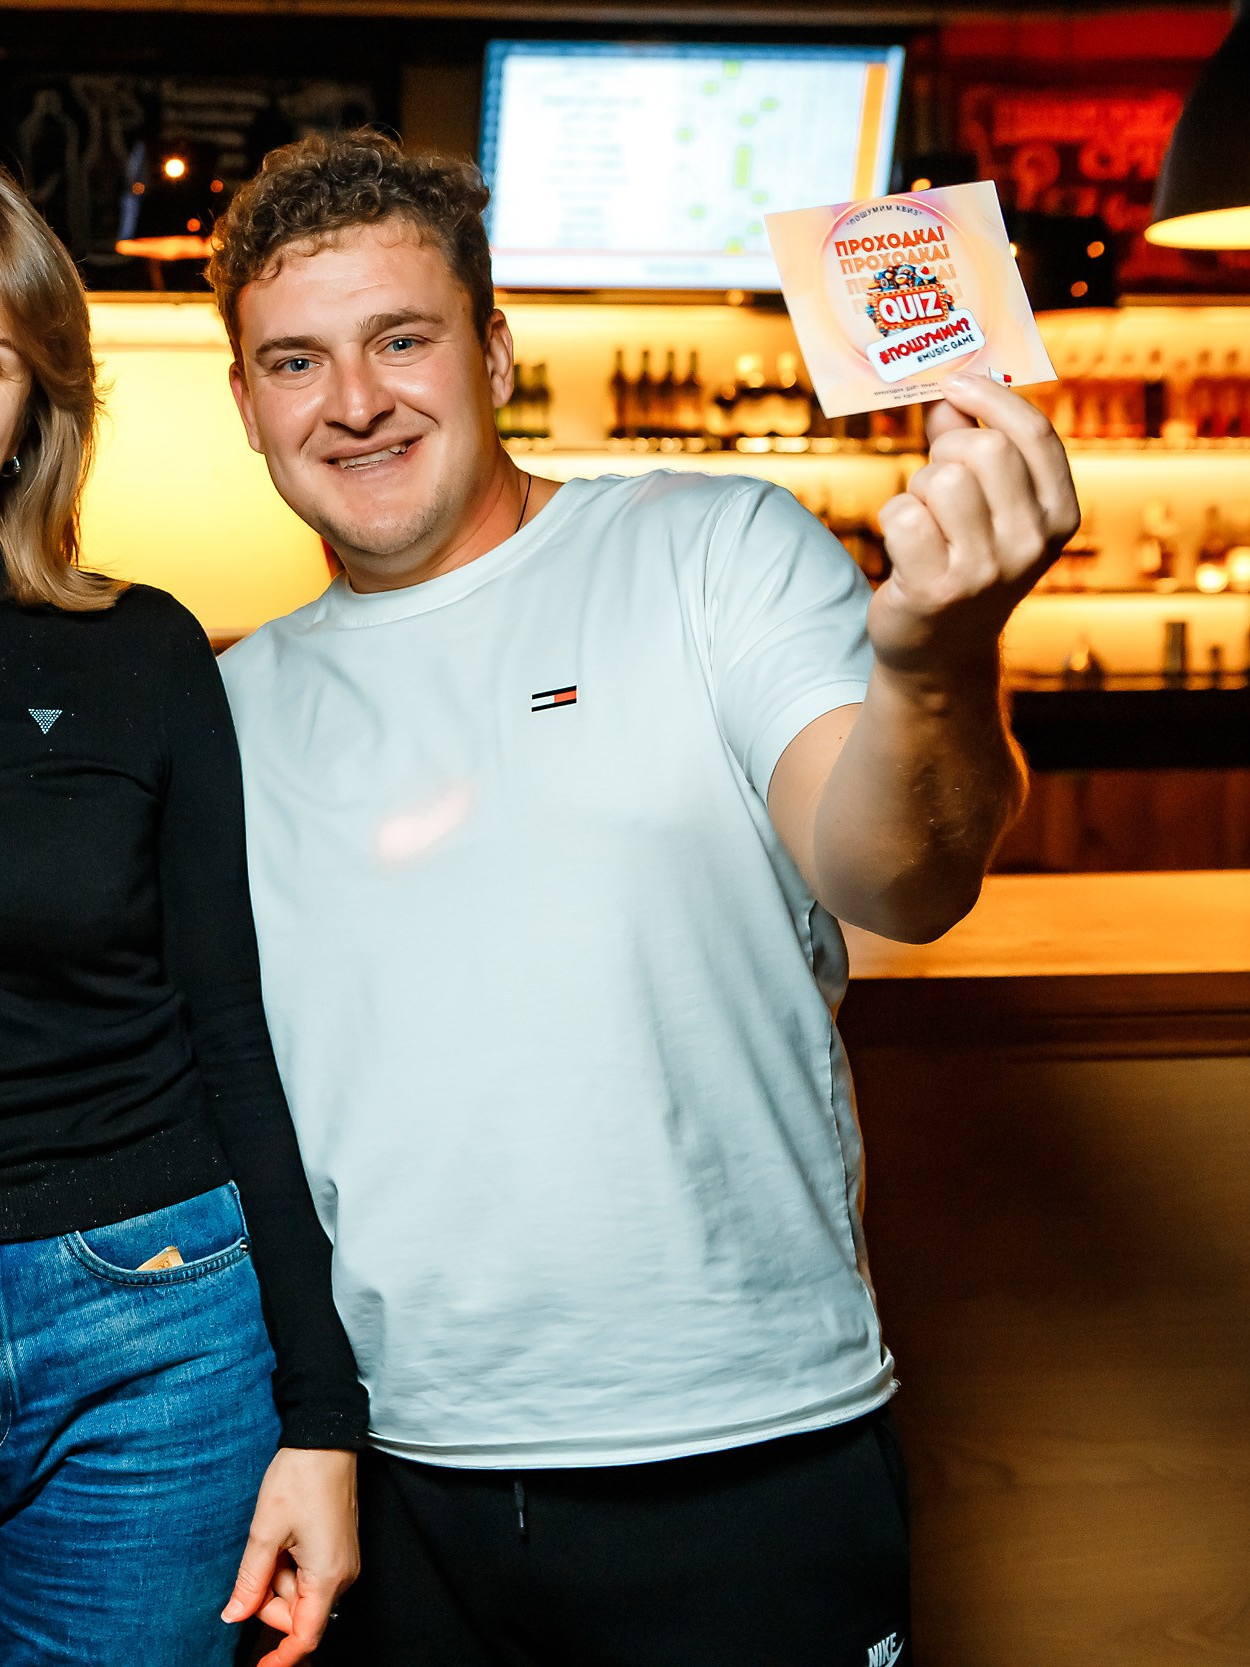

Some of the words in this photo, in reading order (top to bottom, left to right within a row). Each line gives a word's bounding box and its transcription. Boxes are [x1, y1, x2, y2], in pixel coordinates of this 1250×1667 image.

[835, 226, 945, 257] ПРОХОДКА!
[878, 291, 943, 324] QUIZ
[950, 334, 975, 349] GAME
[867, 1632, 897, 1667] NIKE
